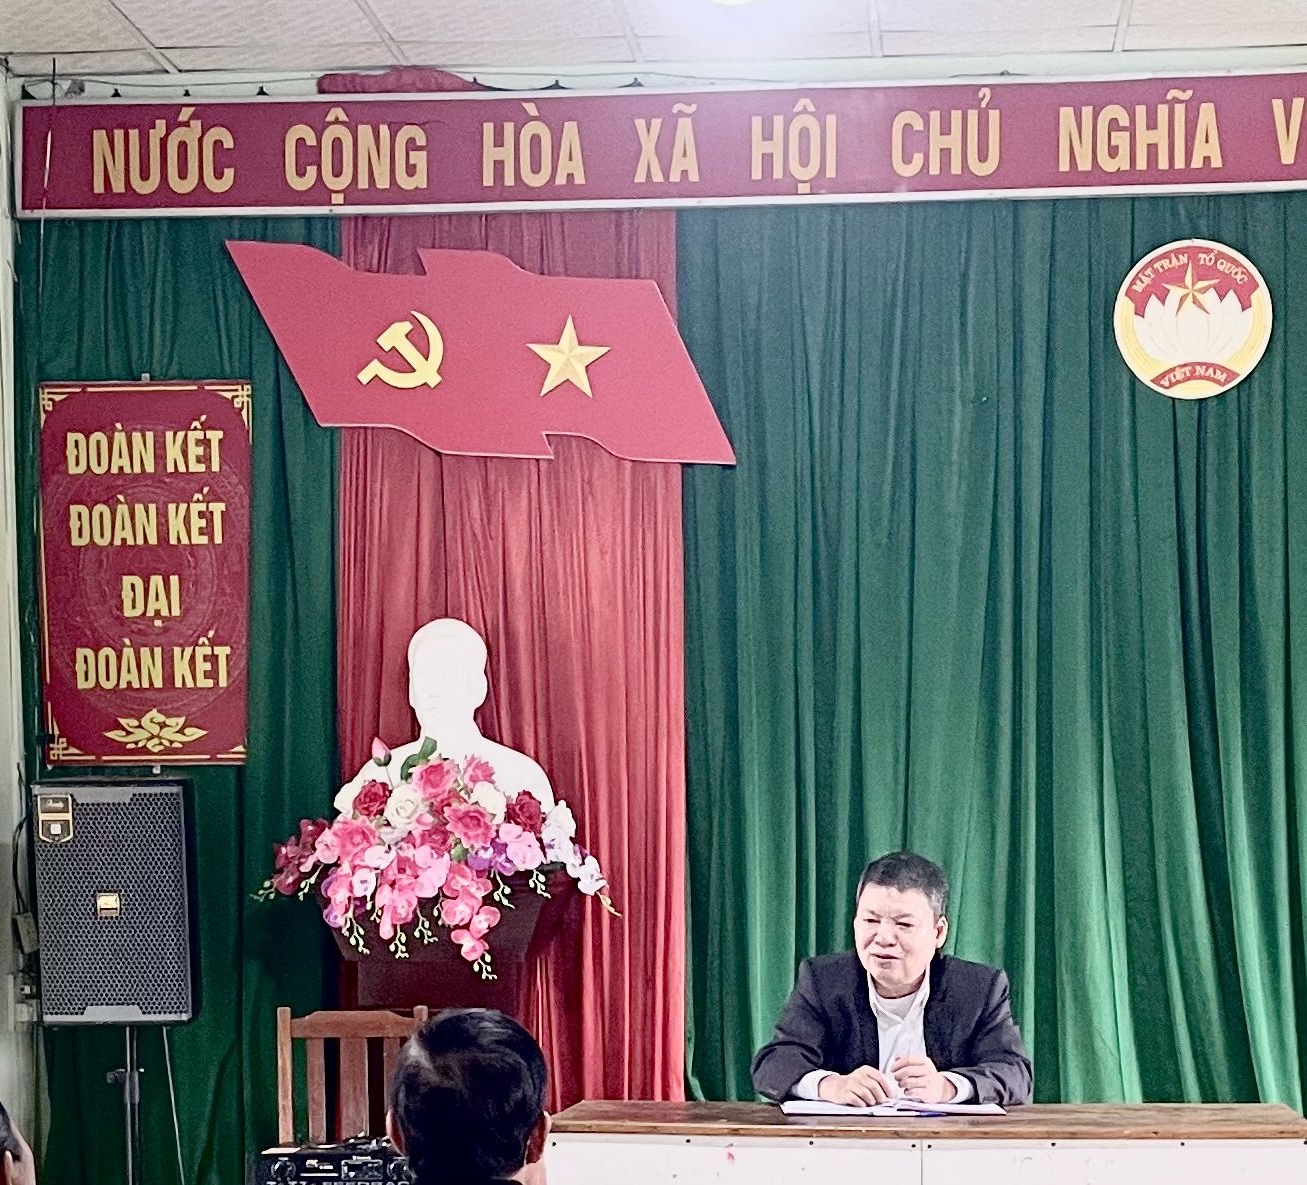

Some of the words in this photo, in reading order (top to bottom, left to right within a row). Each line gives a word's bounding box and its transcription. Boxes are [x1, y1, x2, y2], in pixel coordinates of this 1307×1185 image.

[92, 107, 235, 195] NƯỚC
[284, 108, 429, 205] CỘNG
[481, 101, 587, 189] HÒA
[633, 102, 701, 184] XÃ
[750, 97, 838, 195] HỘI
[891, 87, 1001, 178] CHỦ
[1058, 88, 1223, 174] NGHĨA
[1194, 365, 1228, 383] NAM
[66, 422, 156, 475] ĐOÀN
[165, 414, 224, 474] KẾT
[69, 494, 159, 547] ĐOÀN
[168, 486, 226, 545] KẾT
[121, 575, 181, 628] ĐẠI
[75, 638, 164, 691] ĐOÀN
[173, 630, 231, 689] KẾT
